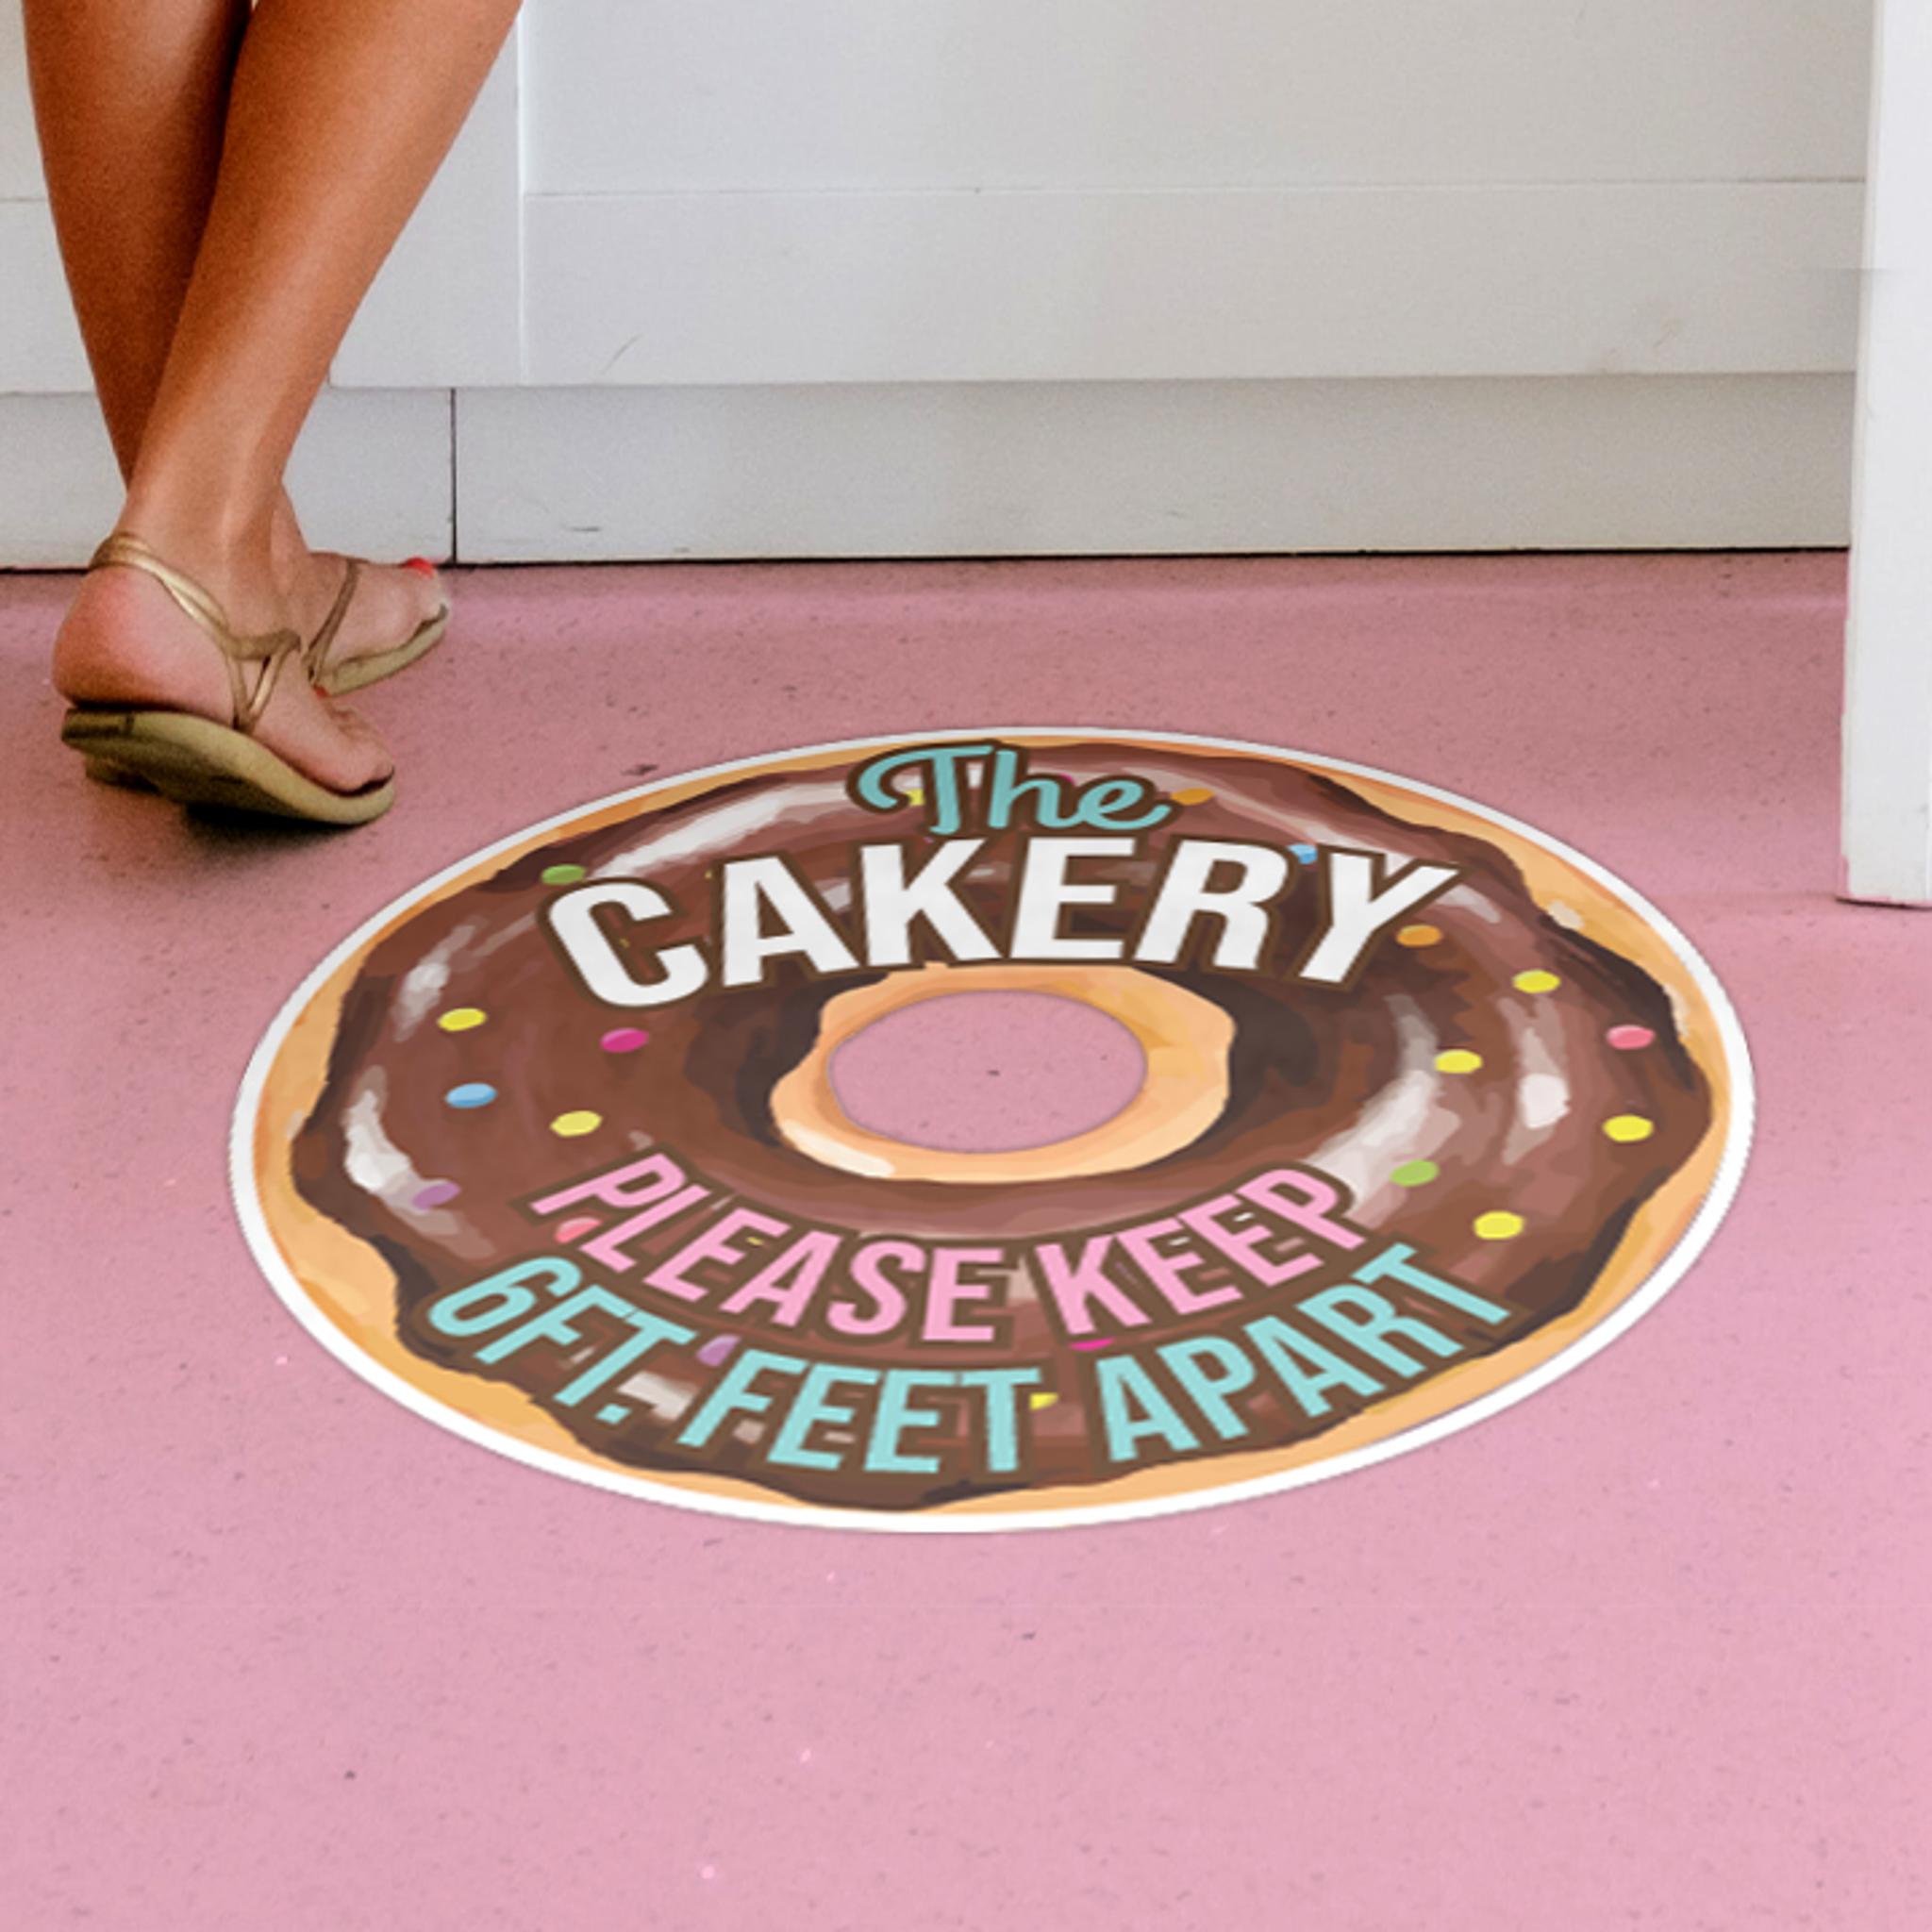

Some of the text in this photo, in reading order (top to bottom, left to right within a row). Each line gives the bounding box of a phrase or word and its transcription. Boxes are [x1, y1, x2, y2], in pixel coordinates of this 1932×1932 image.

[858, 744, 1173, 836] The
[547, 836, 1459, 1008] CAKERY
[529, 1153, 1367, 1341] PLEASE KEEP
[428, 1241, 1511, 1472] 6FT. FEET APART
